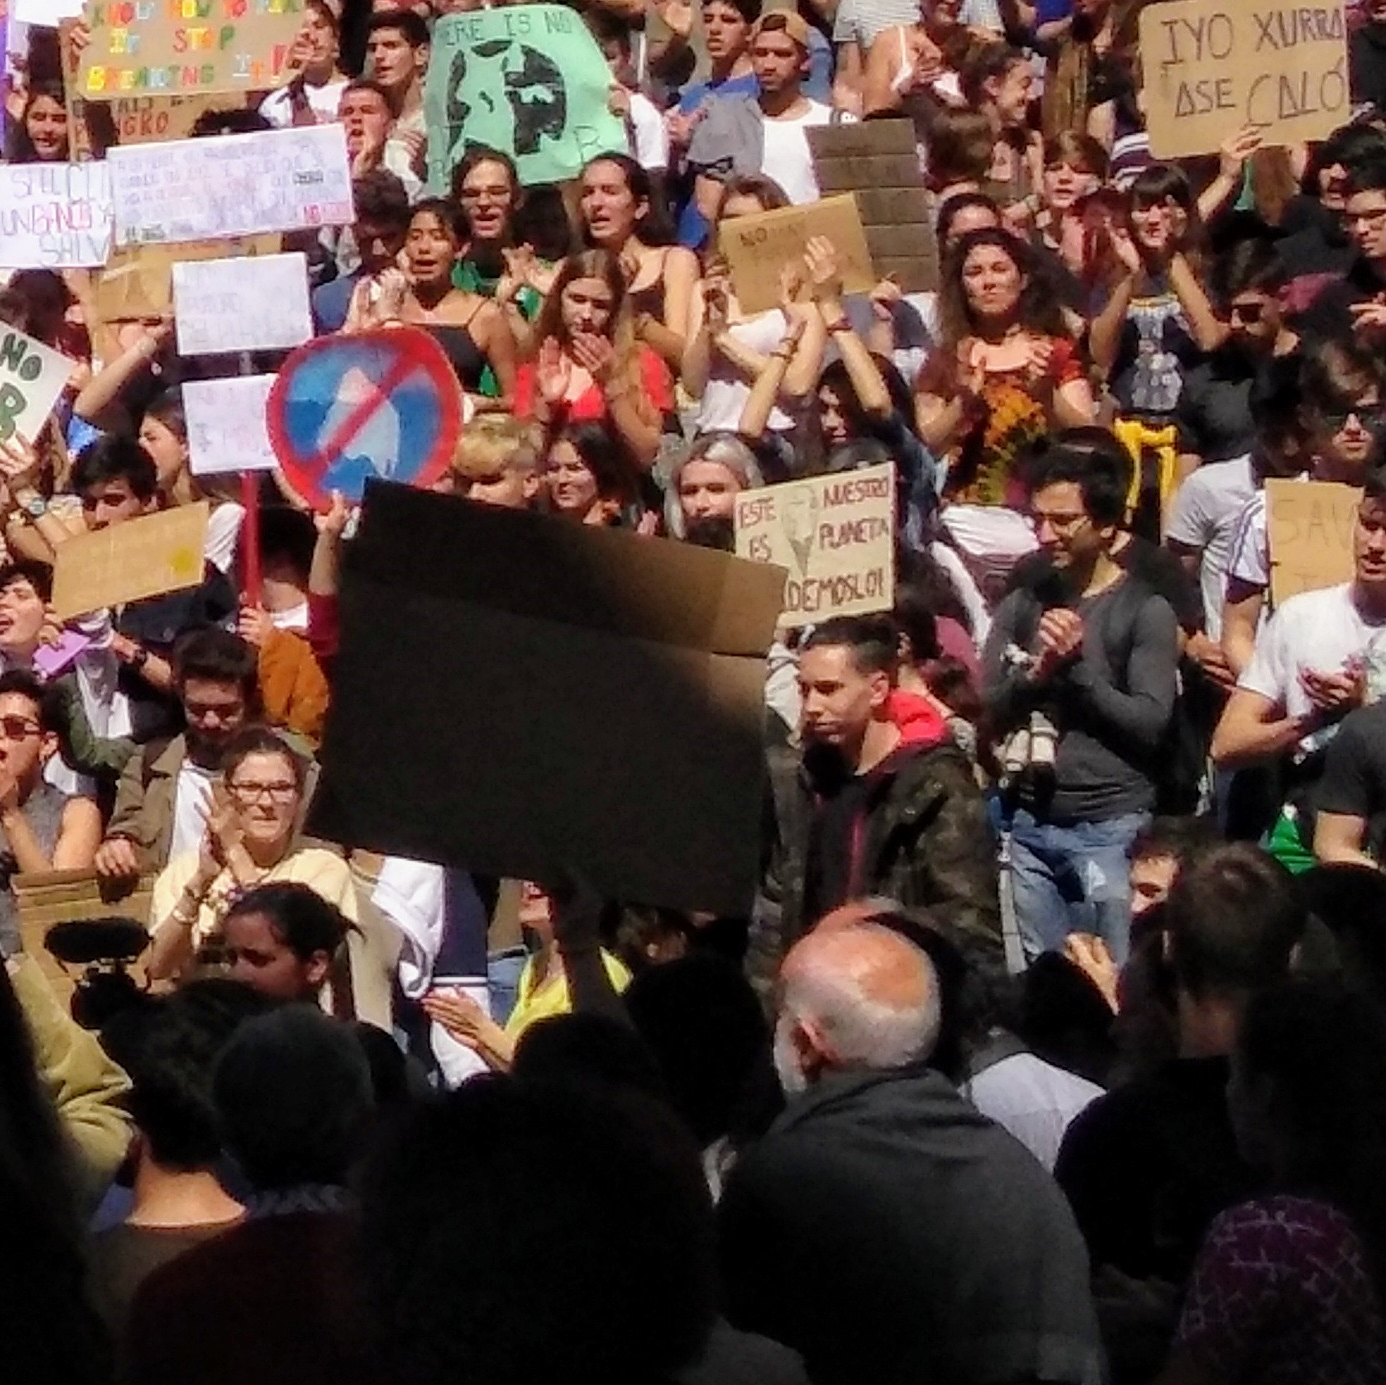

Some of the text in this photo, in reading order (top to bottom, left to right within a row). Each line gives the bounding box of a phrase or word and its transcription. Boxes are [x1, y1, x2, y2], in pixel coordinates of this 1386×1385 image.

[173, 25, 236, 54] STOP
[504, 12, 532, 38] IS
[1161, 14, 1235, 65] IYO
[1175, 77, 1237, 118] ASE
[739, 226, 769, 247] NO
[739, 475, 890, 530] ESTE NUESTRO
[750, 516, 890, 564] ES PLANETA
